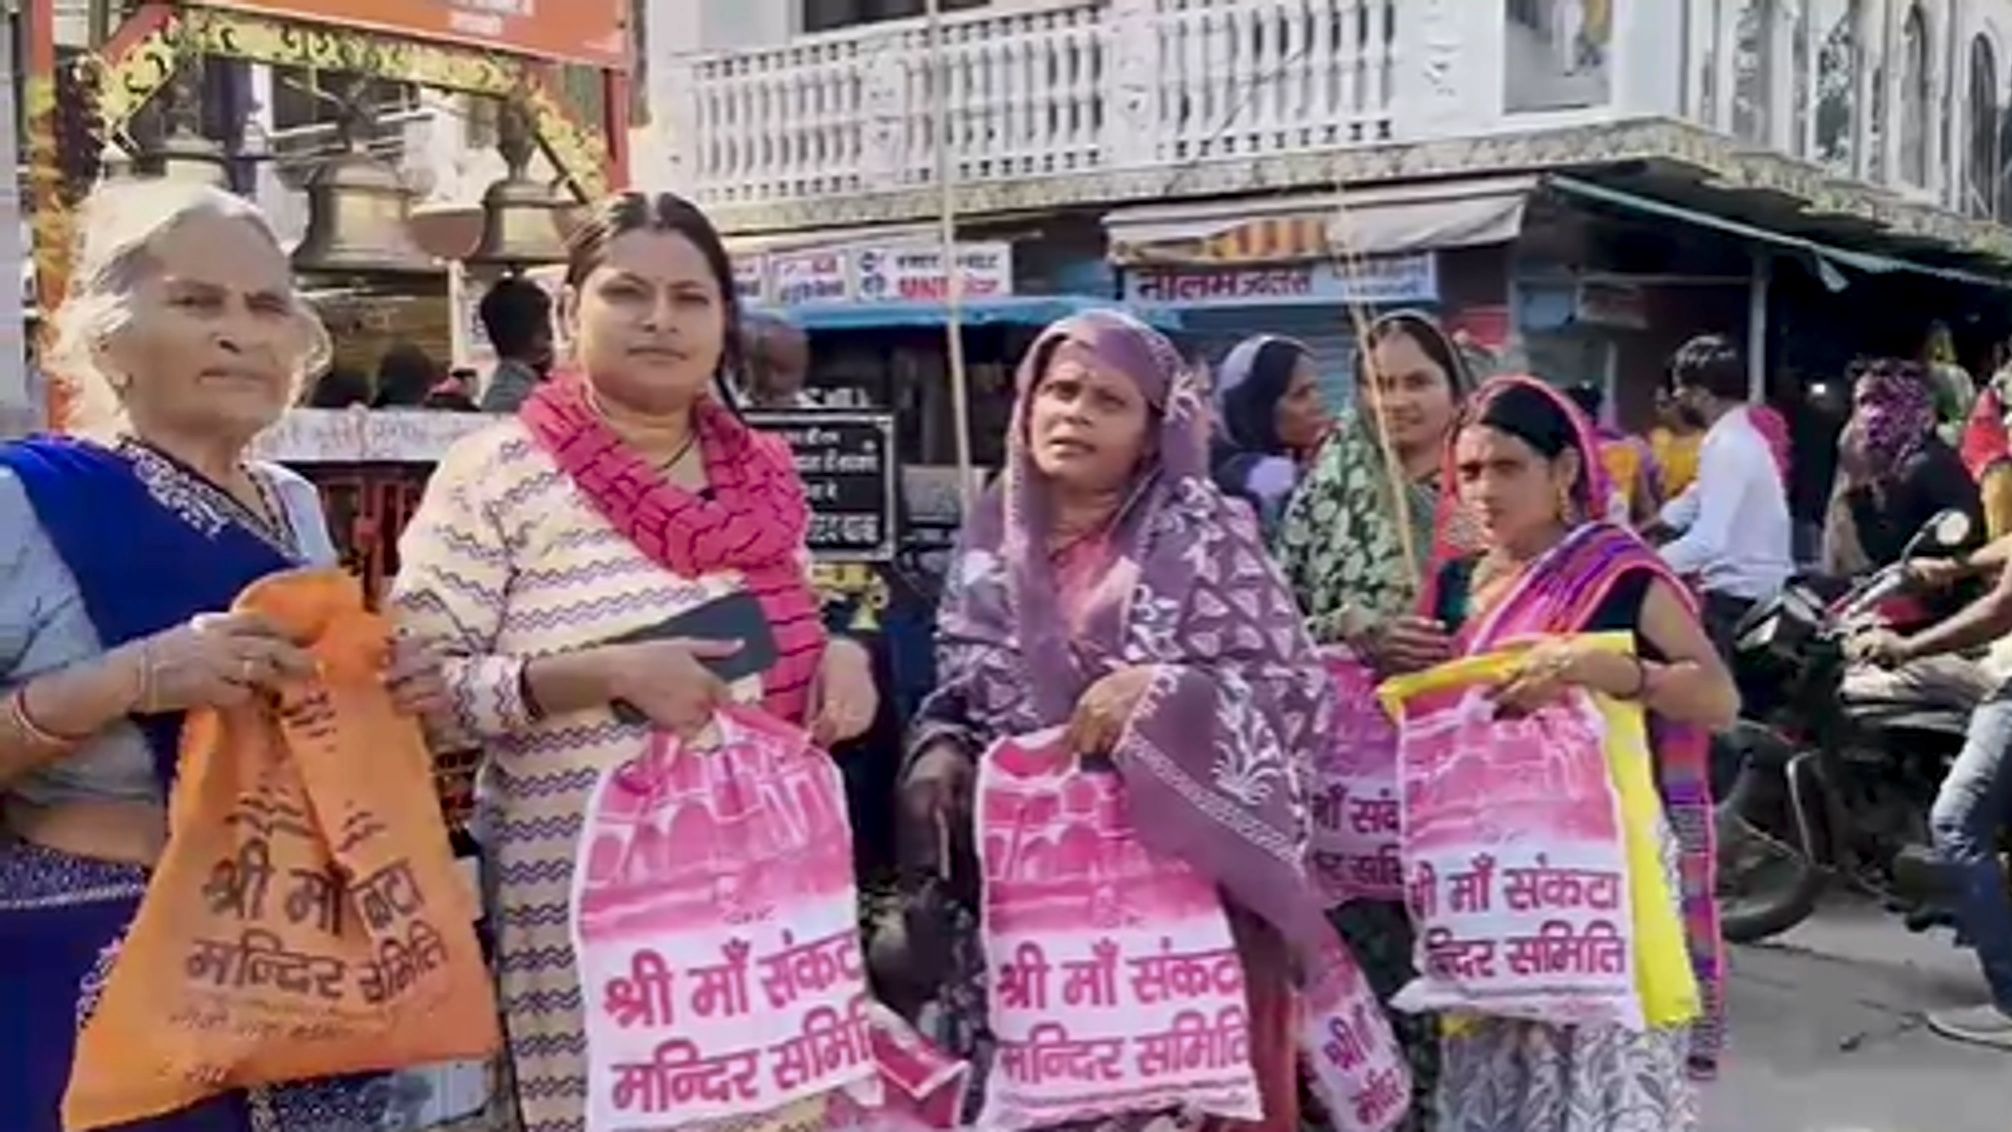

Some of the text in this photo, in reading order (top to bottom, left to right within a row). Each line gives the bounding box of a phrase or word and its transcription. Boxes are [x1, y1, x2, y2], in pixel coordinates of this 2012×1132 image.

[203, 837, 275, 921] श्री
[1446, 852, 1496, 912] माँ
[1503, 851, 1621, 910] संकटा
[186, 928, 349, 999] मन्दिर
[604, 928, 864, 1028] श्री माँ संकट
[997, 936, 1244, 1010] श्री माँ संकट
[1505, 919, 1625, 975] समिति
[610, 1038, 760, 1113] मन्दिर
